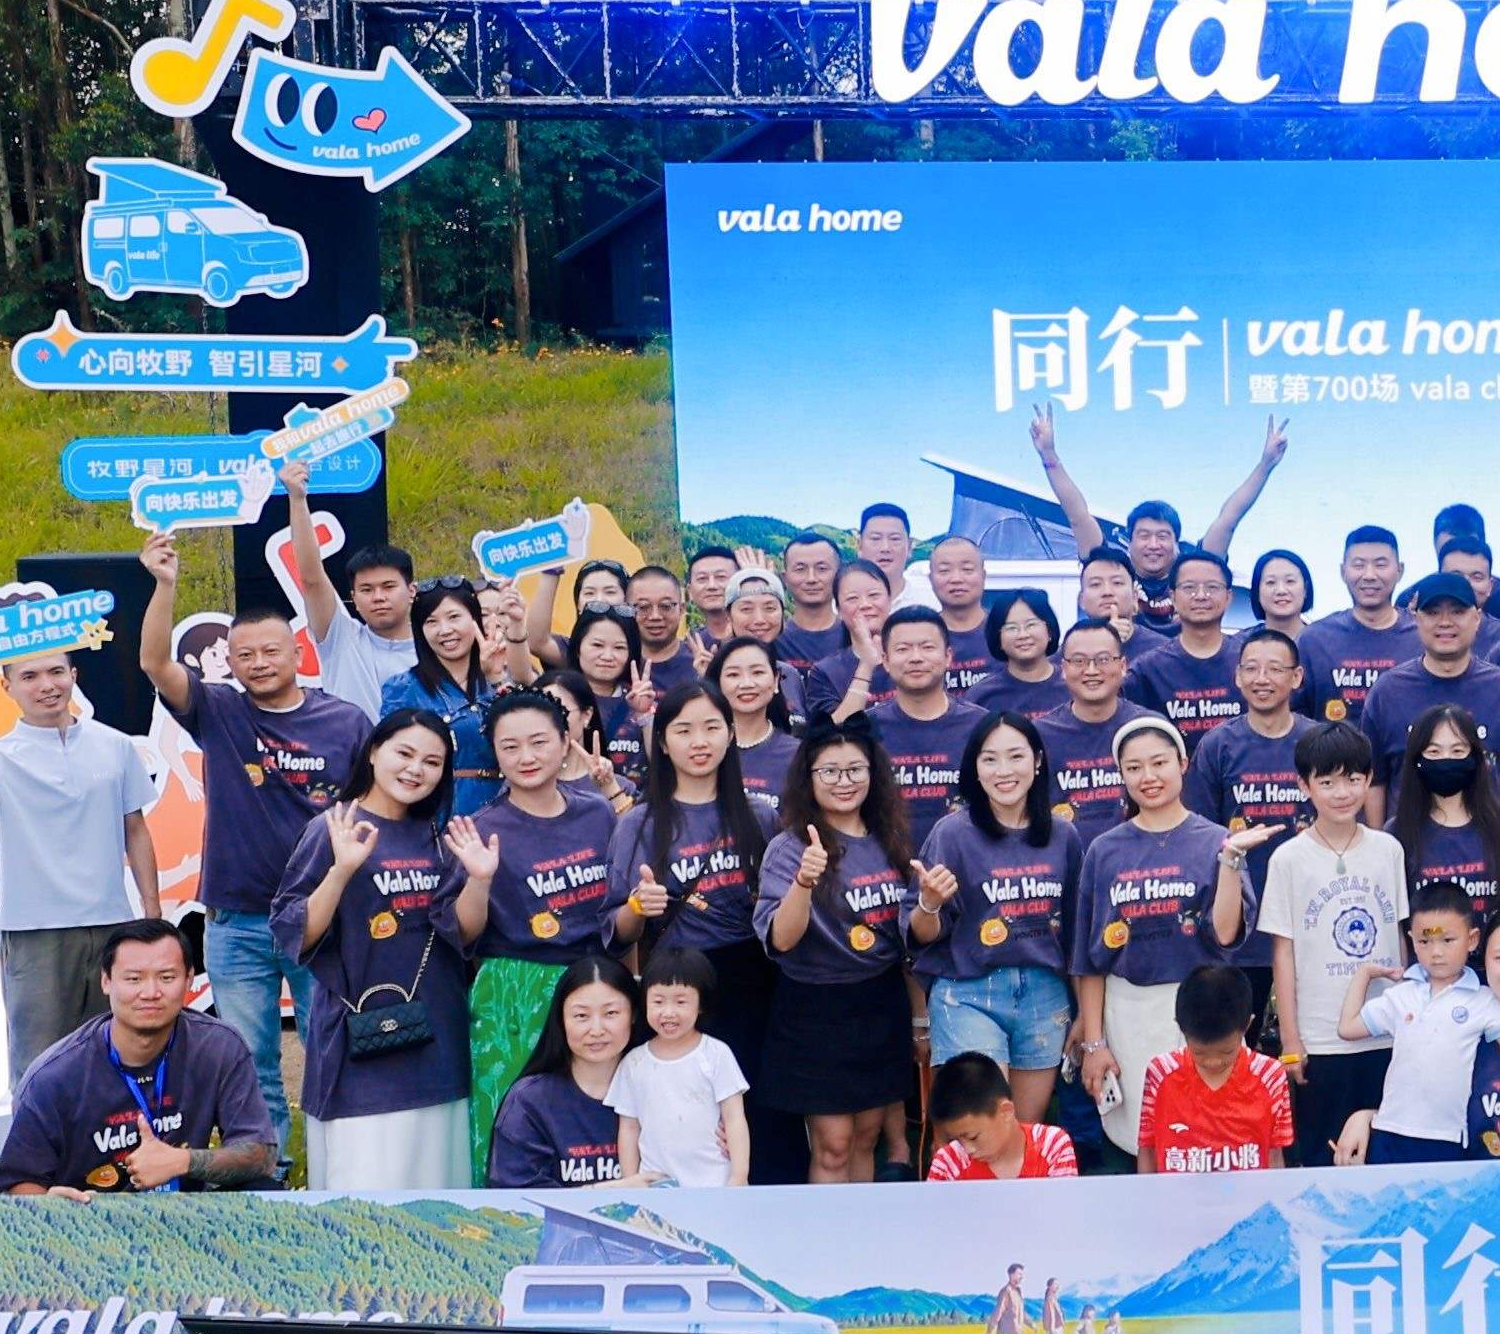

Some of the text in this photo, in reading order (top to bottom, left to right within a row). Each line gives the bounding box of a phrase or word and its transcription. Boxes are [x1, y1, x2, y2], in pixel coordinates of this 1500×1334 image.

[312, 130, 421, 160] vala home
[717, 202, 903, 234] vala home
[1246, 309, 1386, 357] vala
[78, 348, 322, 378] 心向牧野 智引星河
[993, 306, 1202, 413] 同行
[1248, 373, 1399, 404] 暨第700场
[1409, 375, 1470, 403] vala
[346, 387, 399, 420] home
[87, 457, 192, 478] 牧野星河
[145, 490, 239, 513] 向快乐出发
[487, 531, 566, 568] 向快乐出发
[18, 590, 114, 627] home
[1332, 668, 1363, 688] Vala
[1166, 699, 1241, 719] Vala Home
[276, 749, 325, 771] Home
[607, 738, 640, 754] ome
[916, 764, 961, 785] Home
[1057, 770, 1089, 791] Vala
[1232, 784, 1263, 804] Vala
[372, 869, 411, 896] Vala
[526, 862, 609, 898] Vala Hom
[982, 876, 1063, 904] Vala Home
[1109, 878, 1197, 906] Vala Home
[1455, 875, 1498, 897] ome
[845, 885, 881, 913] Vala
[93, 1124, 138, 1153] Vala
[560, 1156, 622, 1182] Vala Ho
